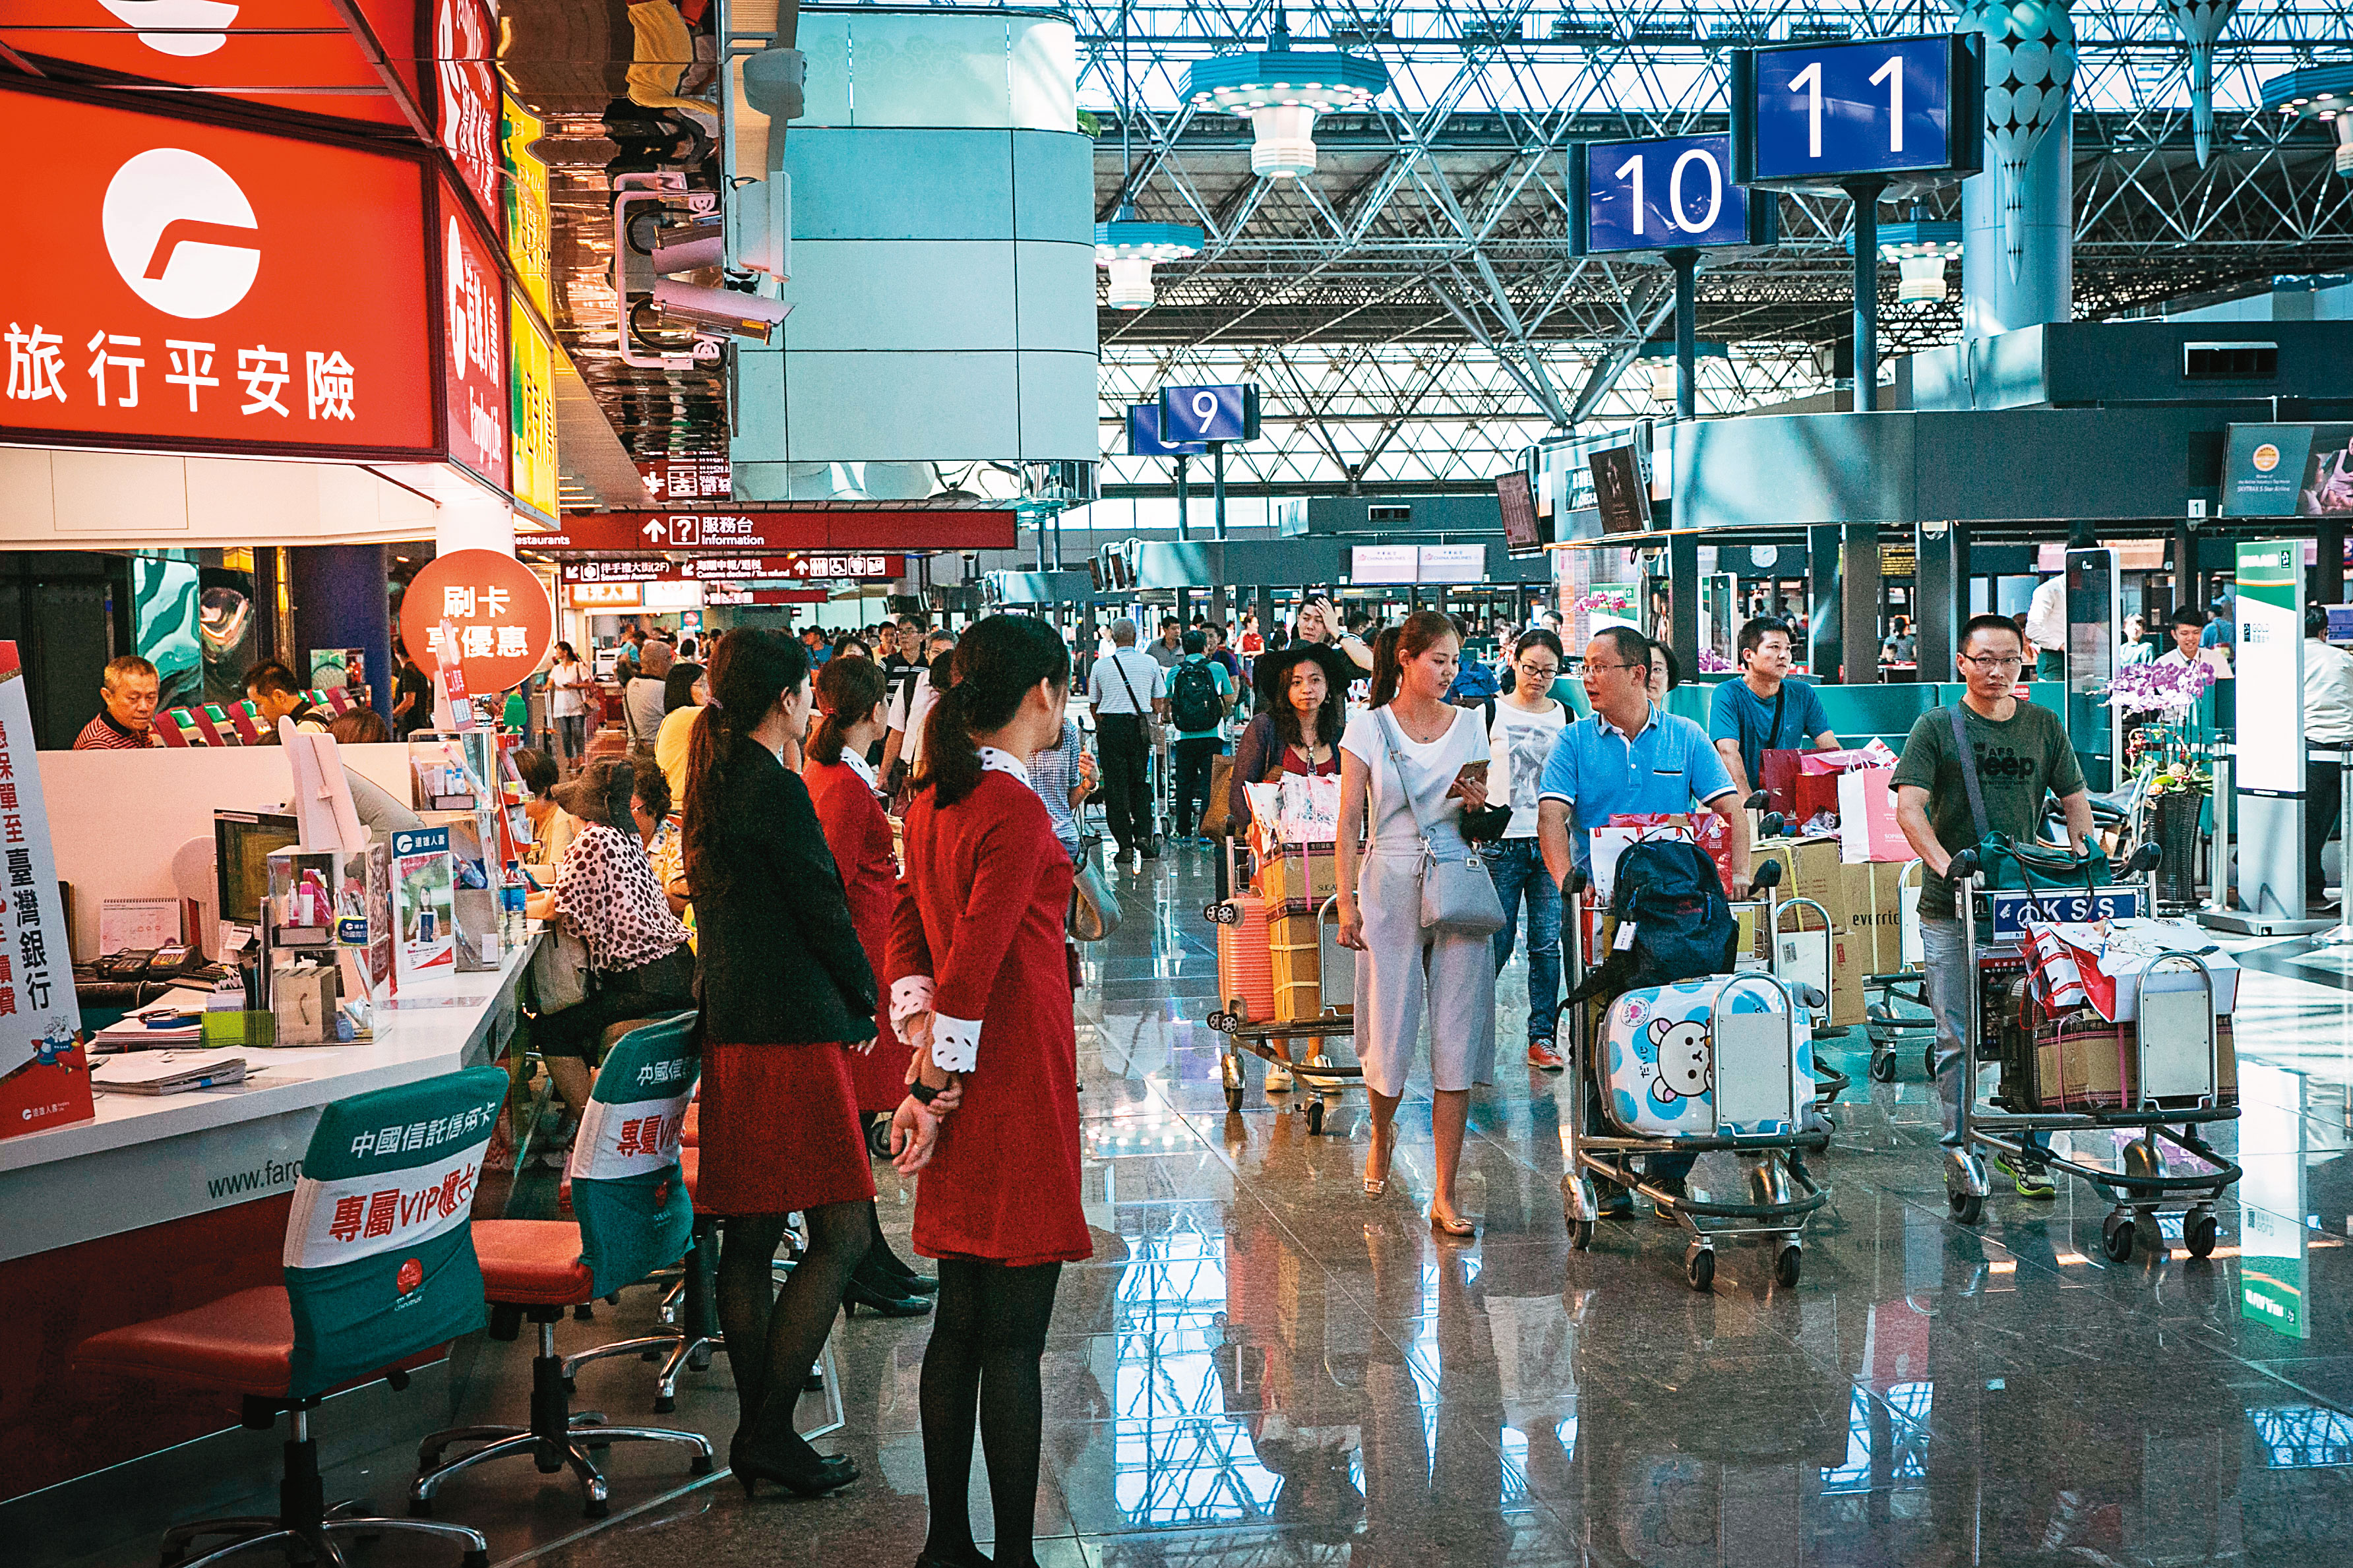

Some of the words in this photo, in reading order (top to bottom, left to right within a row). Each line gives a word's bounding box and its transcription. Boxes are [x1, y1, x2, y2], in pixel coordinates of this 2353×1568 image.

[1787, 56, 1904, 158] 11
[1614, 148, 1723, 235] 10
[3, 322, 357, 423] 旅行平安險
[1192, 391, 1219, 433] 9
[2195, 503, 2200, 515] 1
[702, 516, 754, 534] 服務台
[514, 535, 570, 545] estaurants
[702, 535, 764, 545] Information
[768, 569, 790, 578] refund
[443, 585, 510, 618] 刷卡
[2252, 623, 2270, 632] GOLD
[350, 1101, 496, 1159] 中國信託信用卡
